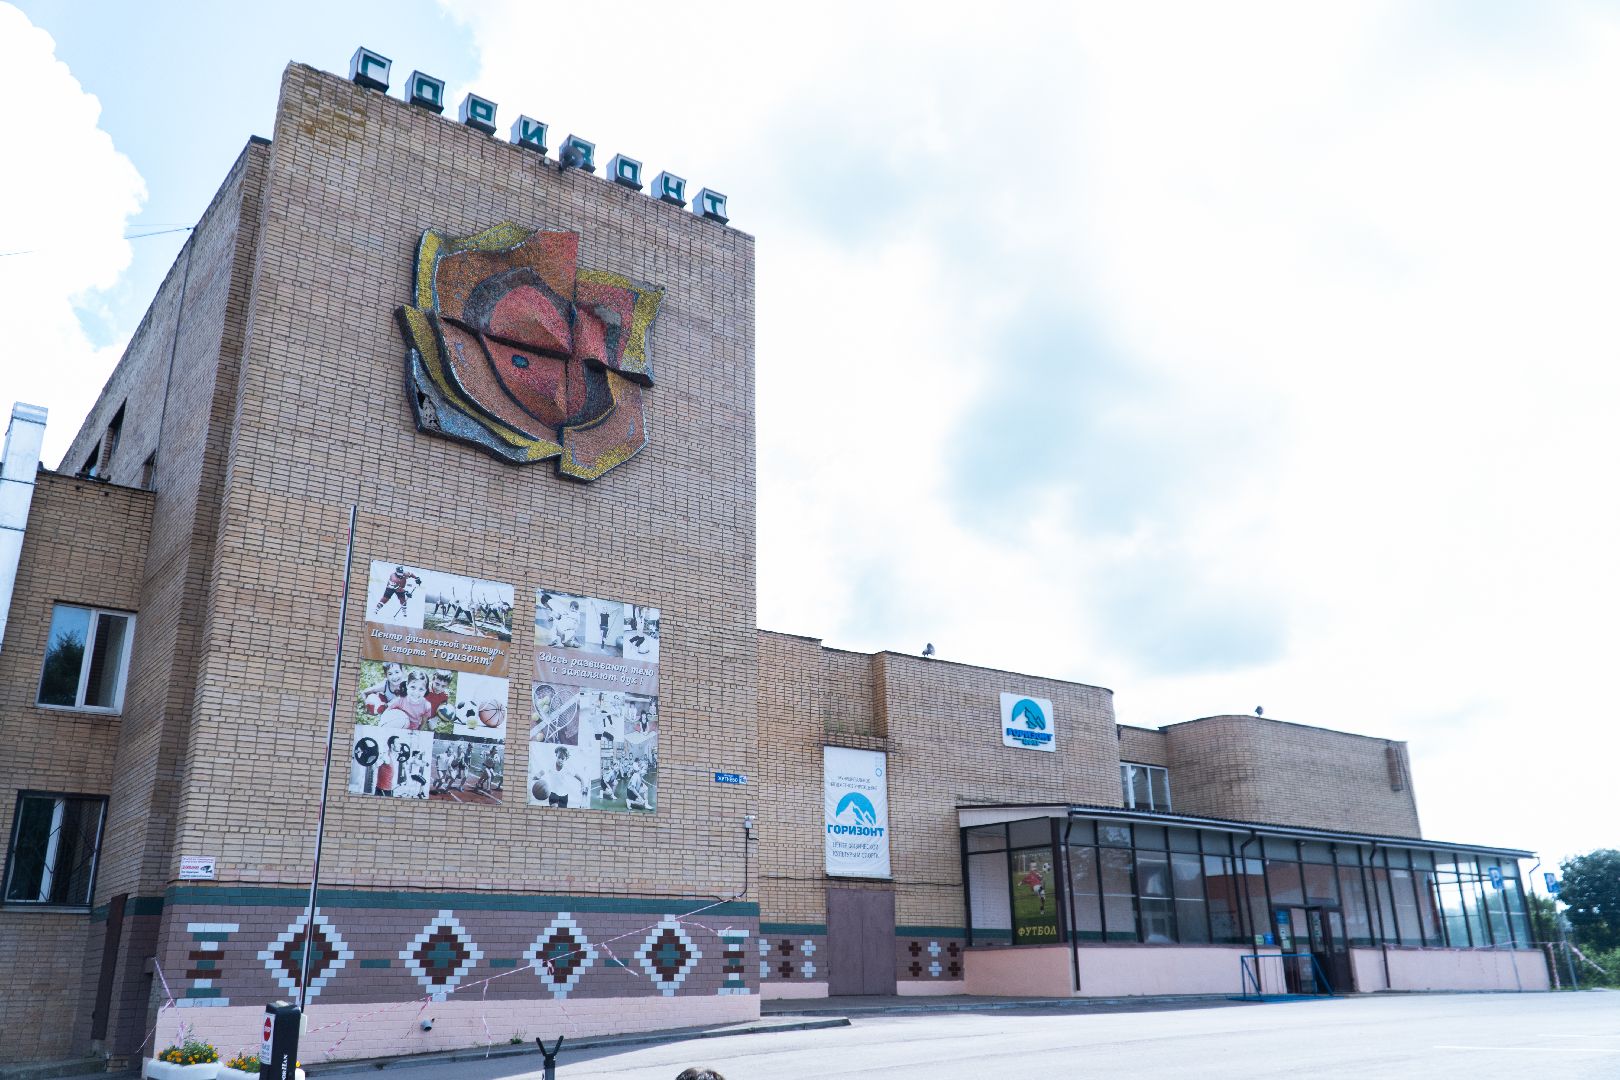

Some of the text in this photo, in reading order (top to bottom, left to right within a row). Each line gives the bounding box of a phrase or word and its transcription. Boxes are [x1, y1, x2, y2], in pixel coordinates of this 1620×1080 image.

[370, 628, 505, 656] Центр физической культуры
[391, 646, 427, 657] спорта
[539, 652, 655, 677] Здесь развивают тело
[561, 668, 618, 682] закаляют
[620, 671, 638, 685] дух
[827, 824, 885, 837] ГОРИЗОНТ
[1018, 926, 1057, 936] ФУТБОЛ
